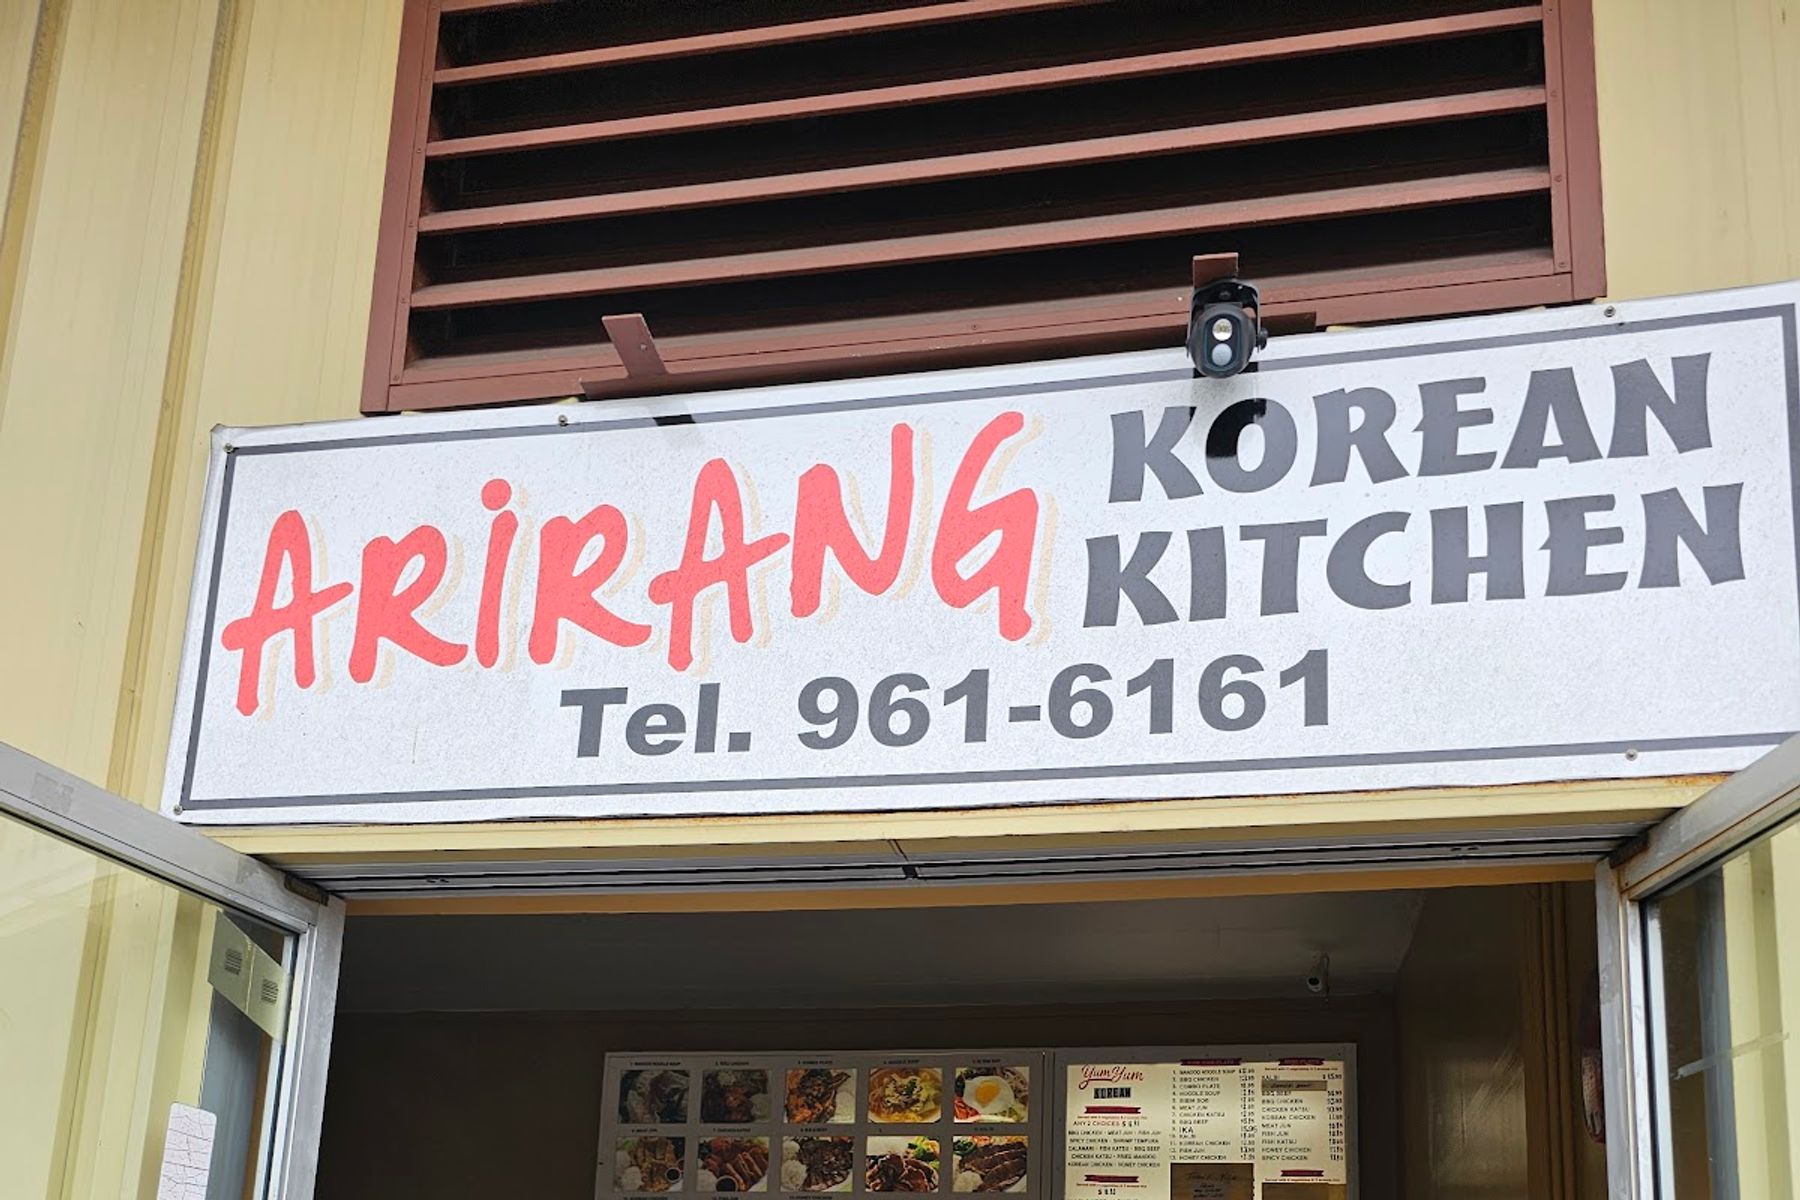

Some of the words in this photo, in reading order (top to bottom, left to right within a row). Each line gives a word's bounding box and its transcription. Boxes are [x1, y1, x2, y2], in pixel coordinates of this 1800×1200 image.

[1107, 352, 1712, 504] KOREAN
[222, 411, 1041, 716] ARIRANG
[1082, 481, 1746, 630] KITCHEN
[560, 681, 752, 758] Tel.
[798, 647, 1330, 751] 961-6161
[1094, 1087, 1131, 1099] KOREAN
